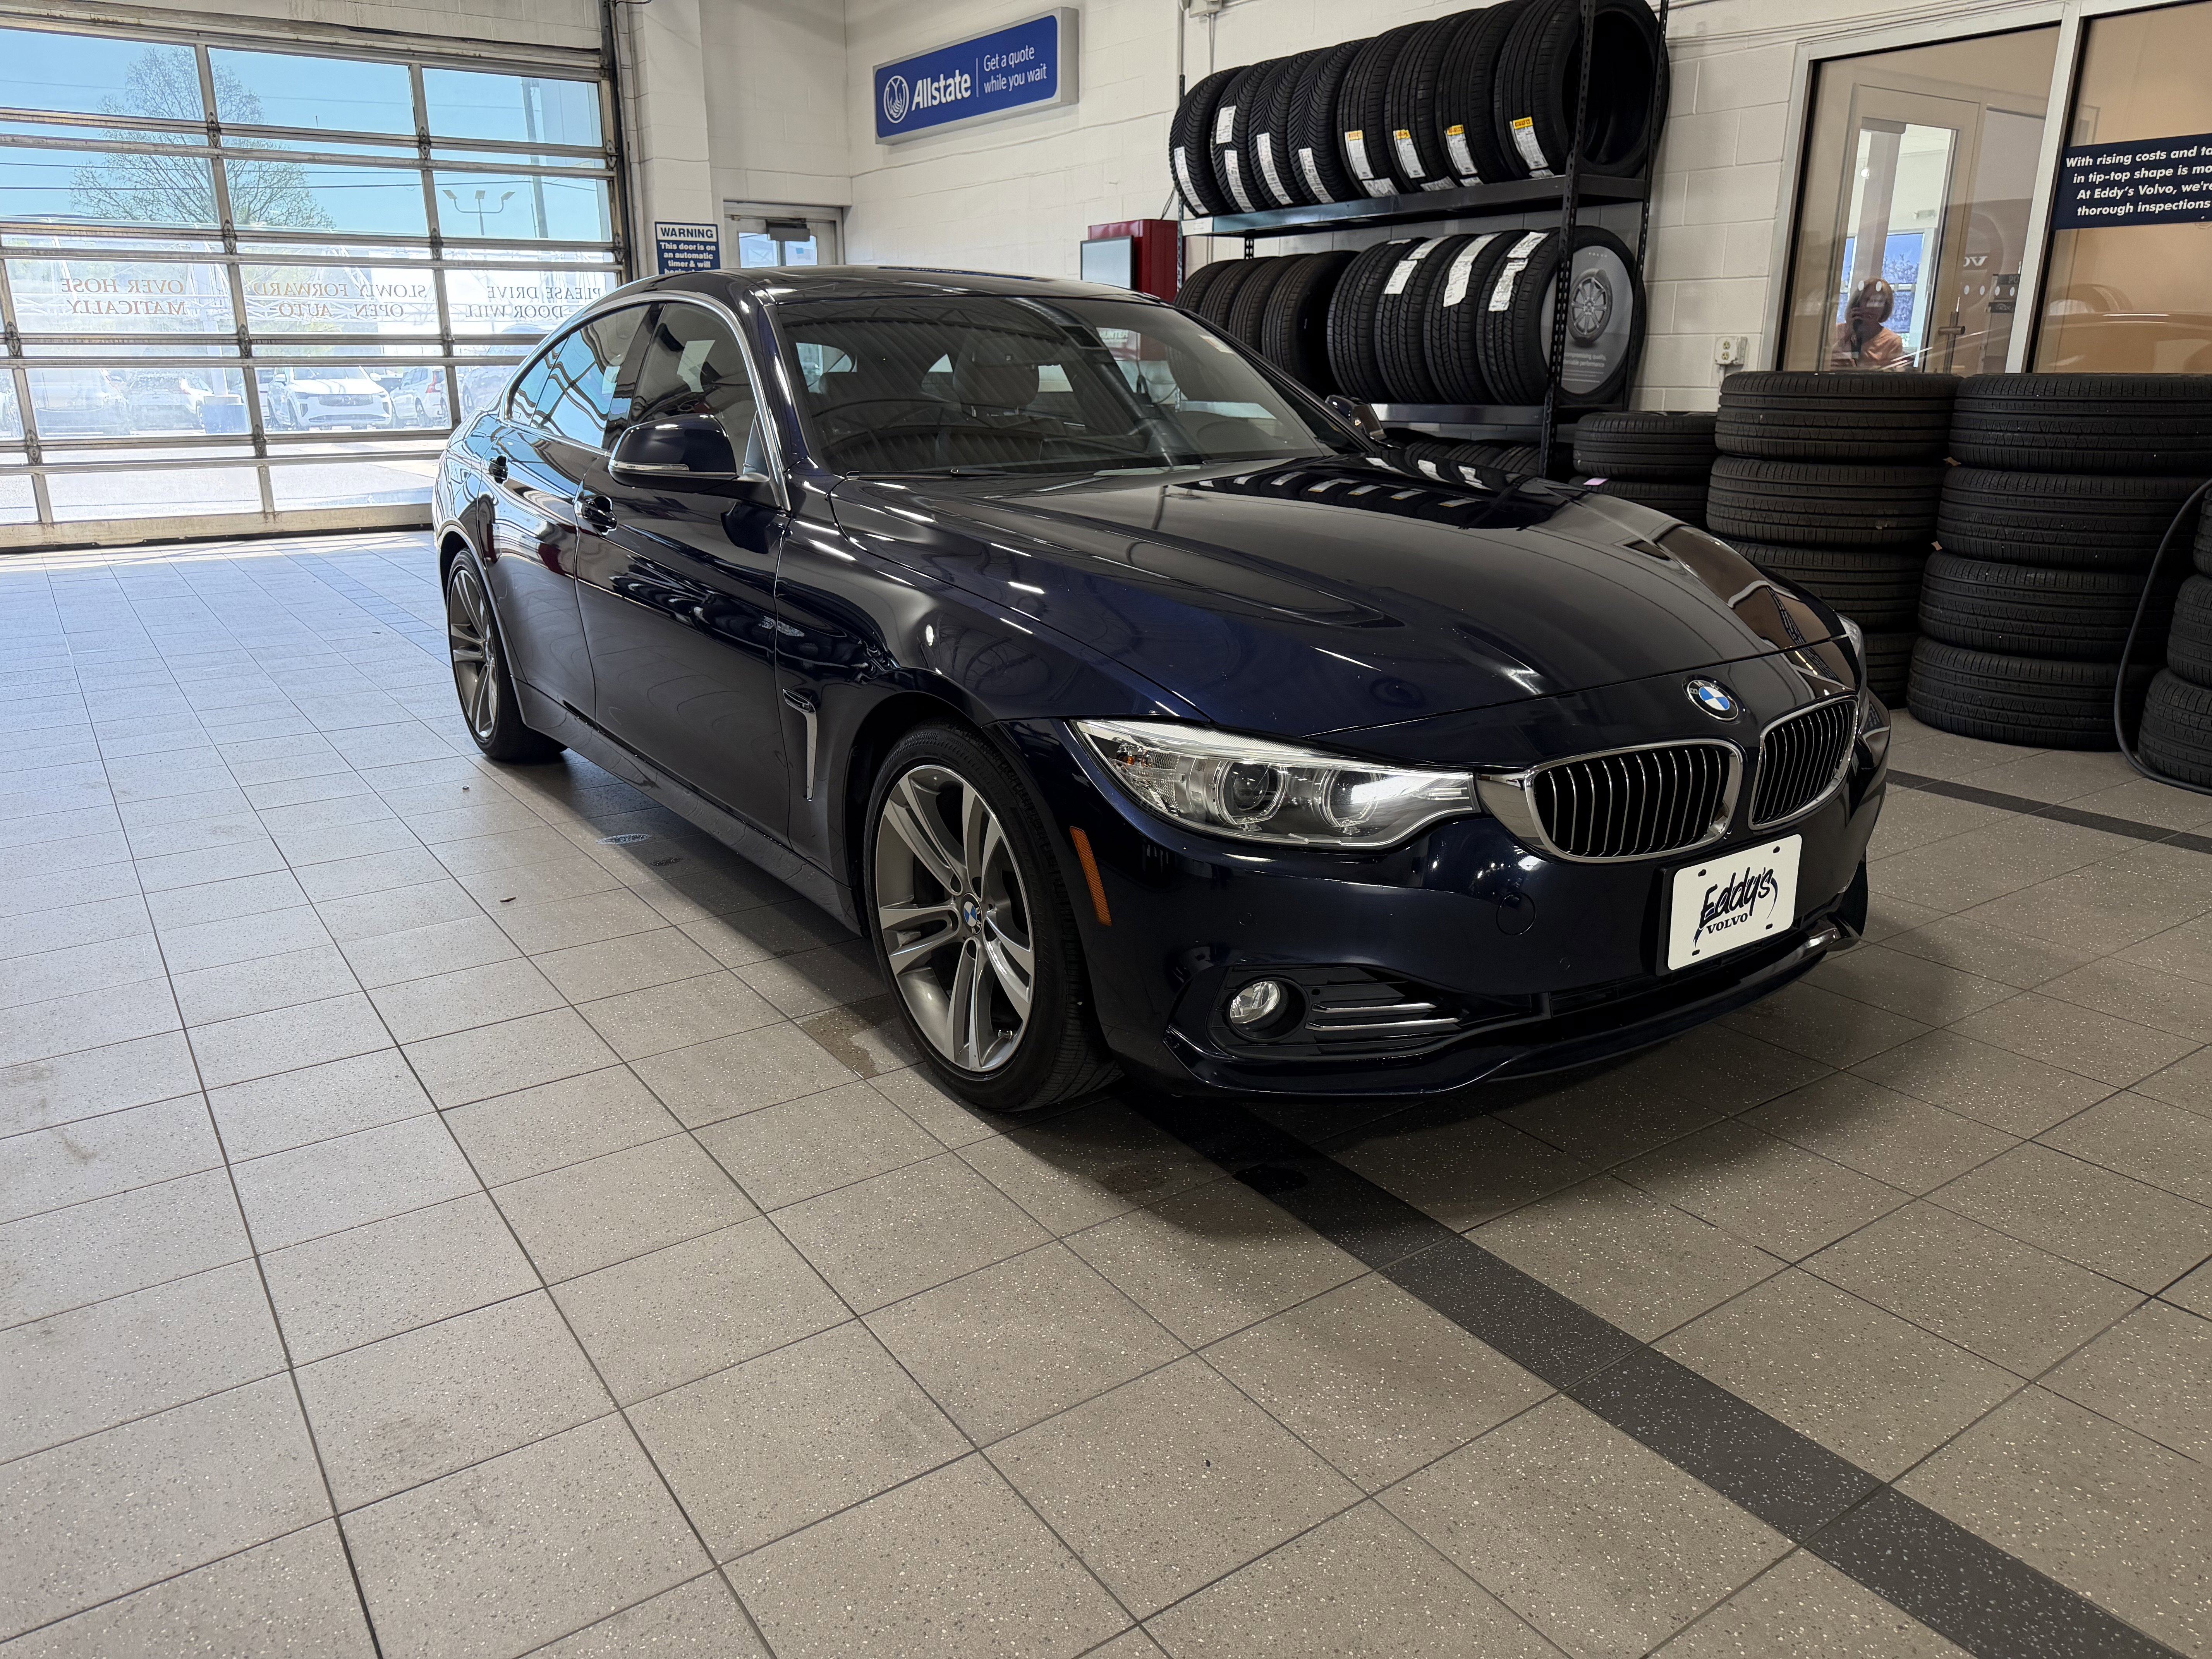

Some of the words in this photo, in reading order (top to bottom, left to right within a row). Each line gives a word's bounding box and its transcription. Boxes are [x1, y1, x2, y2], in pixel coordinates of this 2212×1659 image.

[984, 54, 999, 72] Get
[1001, 55, 1007, 67] a
[1008, 45, 1035, 65] quote
[984, 73, 1007, 94] while
[1008, 72, 1025, 91] you
[1027, 63, 1047, 82] wait
[911, 69, 971, 111] Allstate
[2066, 156, 2093, 167] With
[2097, 153, 2132, 165] rising
[2136, 150, 2166, 162] costs
[2171, 146, 2197, 158] and
[2073, 173, 2085, 184] in
[2088, 170, 2130, 184] tip-top
[2134, 168, 2173, 180] shape
[2178, 165, 2188, 175] is
[2077, 189, 2091, 199] At
[2094, 186, 2134, 199] Eddy's
[2139, 184, 2177, 195] Volvo,
[2078, 203, 2133, 216] thorough
[2137, 199, 2210, 213] inspections
[661, 227, 713, 238] WARNING
[1699, 867, 1774, 929] Eddy's
[1706, 913, 1748, 934] VOLVO
